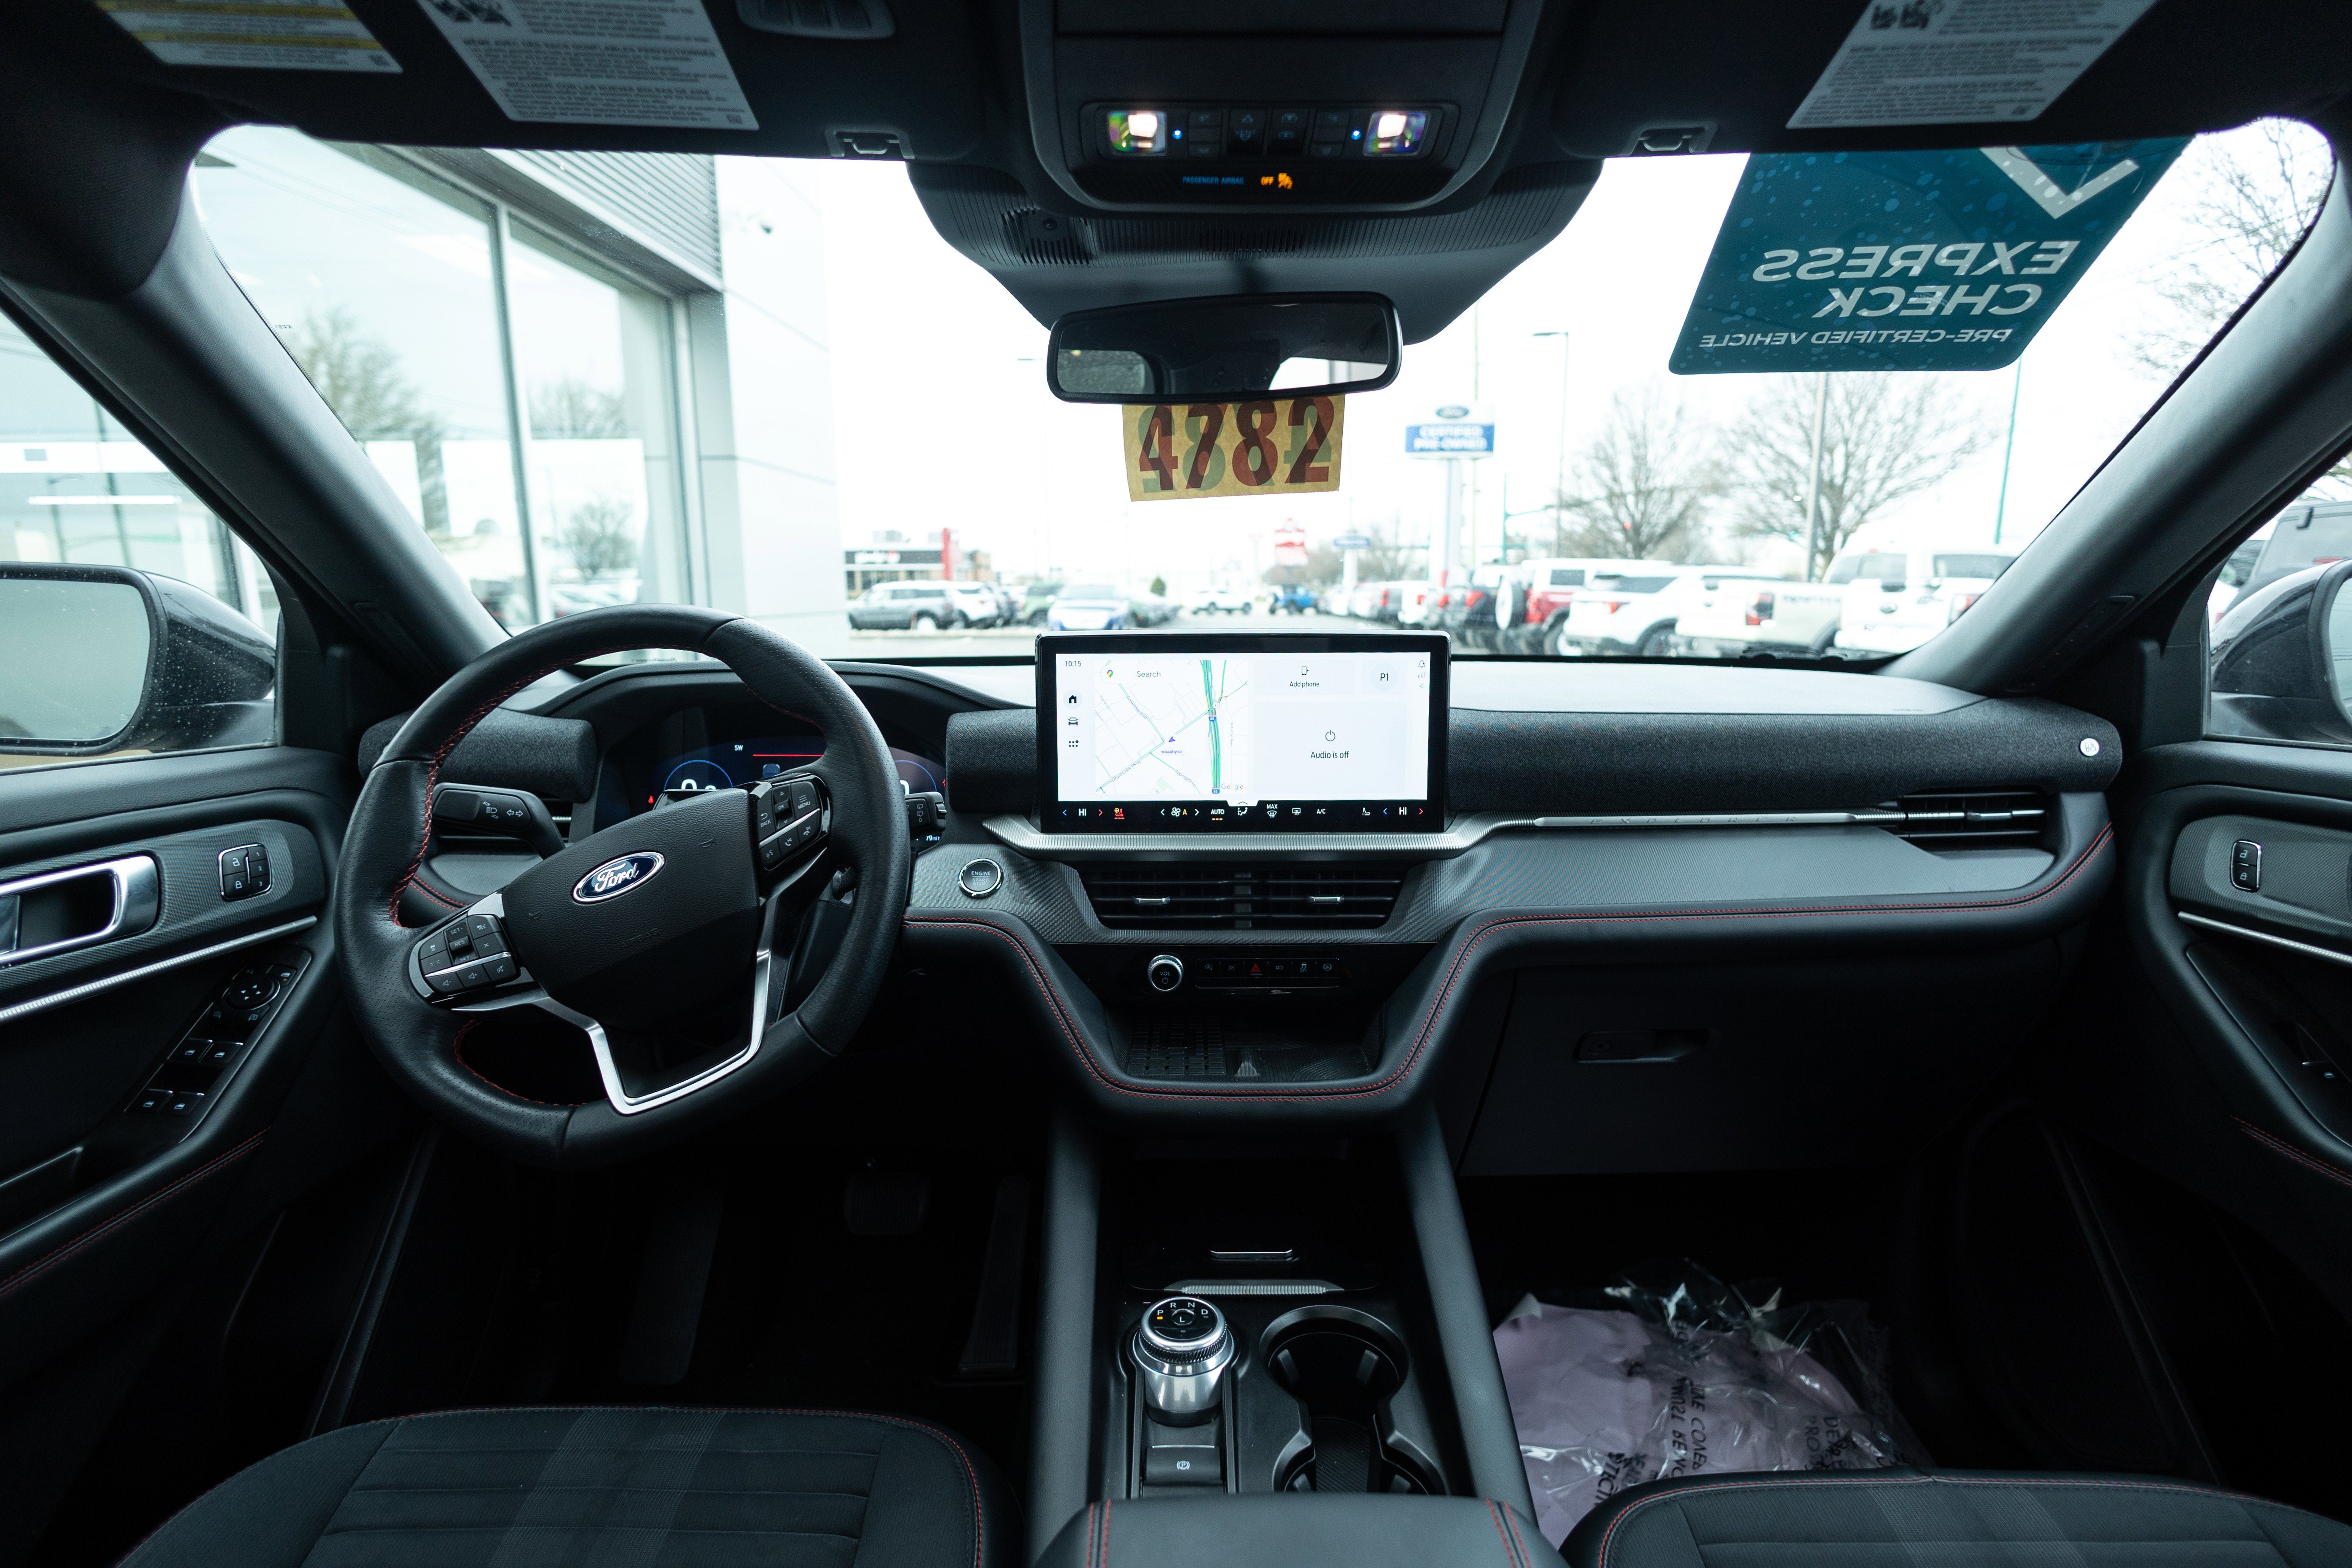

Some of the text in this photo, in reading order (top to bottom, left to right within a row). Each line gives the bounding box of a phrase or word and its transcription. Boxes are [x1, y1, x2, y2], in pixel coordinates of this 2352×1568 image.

[1182, 176, 1244, 185] PASSENGER AIRBAG
[1260, 176, 1274, 186] OFF
[1139, 397, 1334, 491] 4782
[1380, 673, 1389, 681] P1
[797, 801, 811, 810] MENU
[760, 819, 772, 827] BACK
[594, 863, 640, 892] Ford
